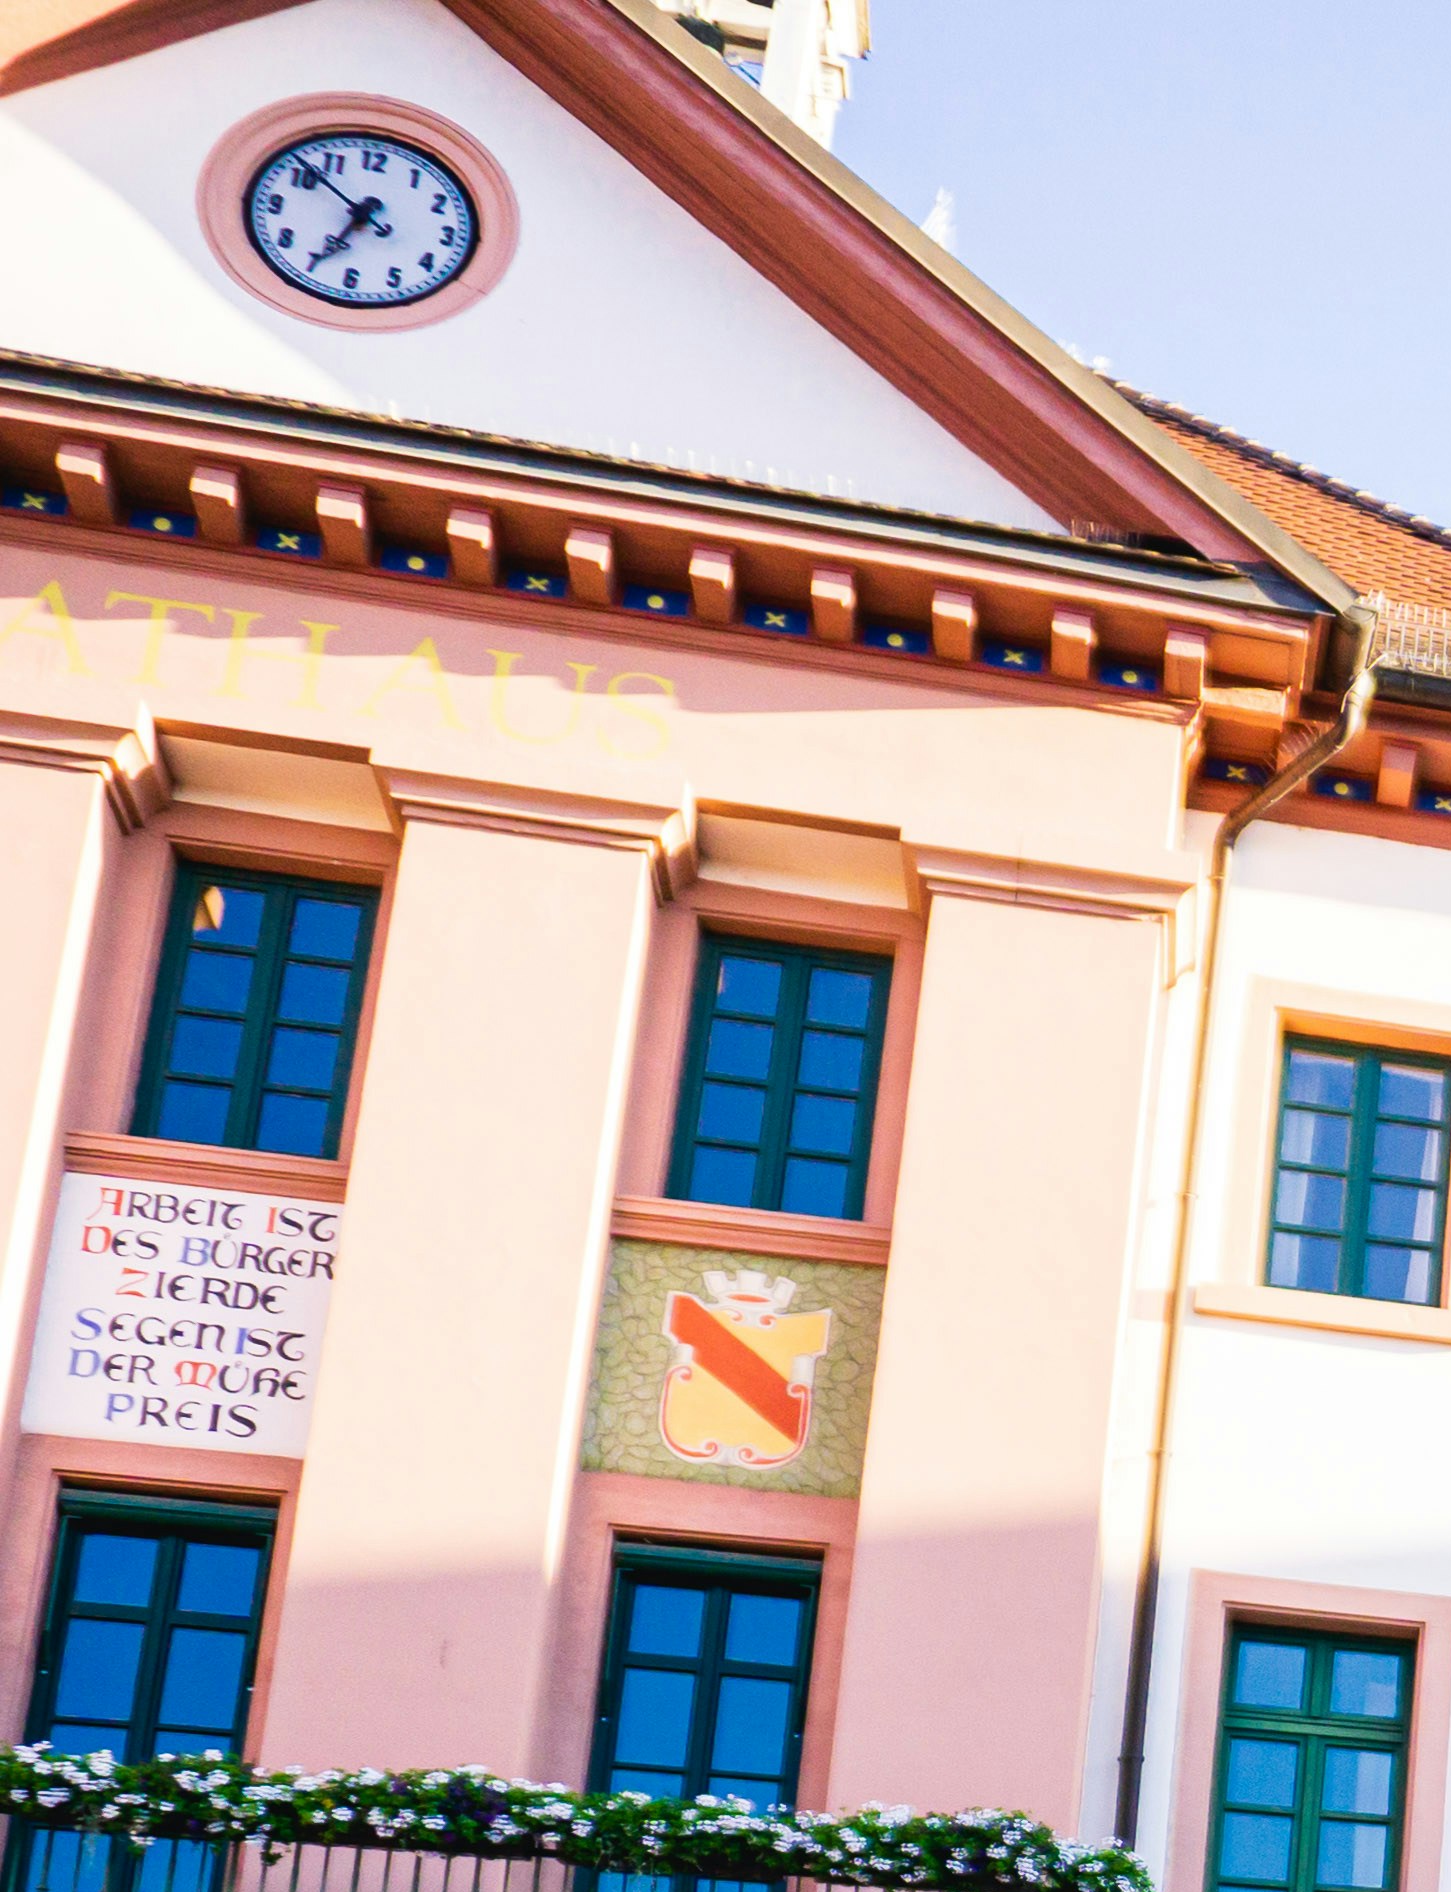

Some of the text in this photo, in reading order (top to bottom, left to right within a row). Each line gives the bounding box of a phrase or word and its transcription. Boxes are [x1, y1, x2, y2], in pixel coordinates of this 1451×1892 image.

[324, 152, 344, 175] 11
[361, 150, 388, 173] 12
[410, 168, 420, 189] 1
[268, 194, 284, 215] 9
[431, 193, 448, 215] 2
[279, 228, 294, 248] 8
[440, 227, 455, 247] 3
[419, 252, 434, 273] 4
[343, 268, 360, 289] 6
[387, 268, 402, 288] 5
[0, 580, 677, 760] ATHAUS
[86, 1187, 338, 1242] ARBEIT IST
[80, 1225, 336, 1280] DES BÜRGER
[115, 1267, 288, 1315] ZIERDE
[70, 1307, 306, 1362] SEGEN IST
[67, 1347, 159, 1386] DER
[103, 1392, 259, 1438] PREIS
